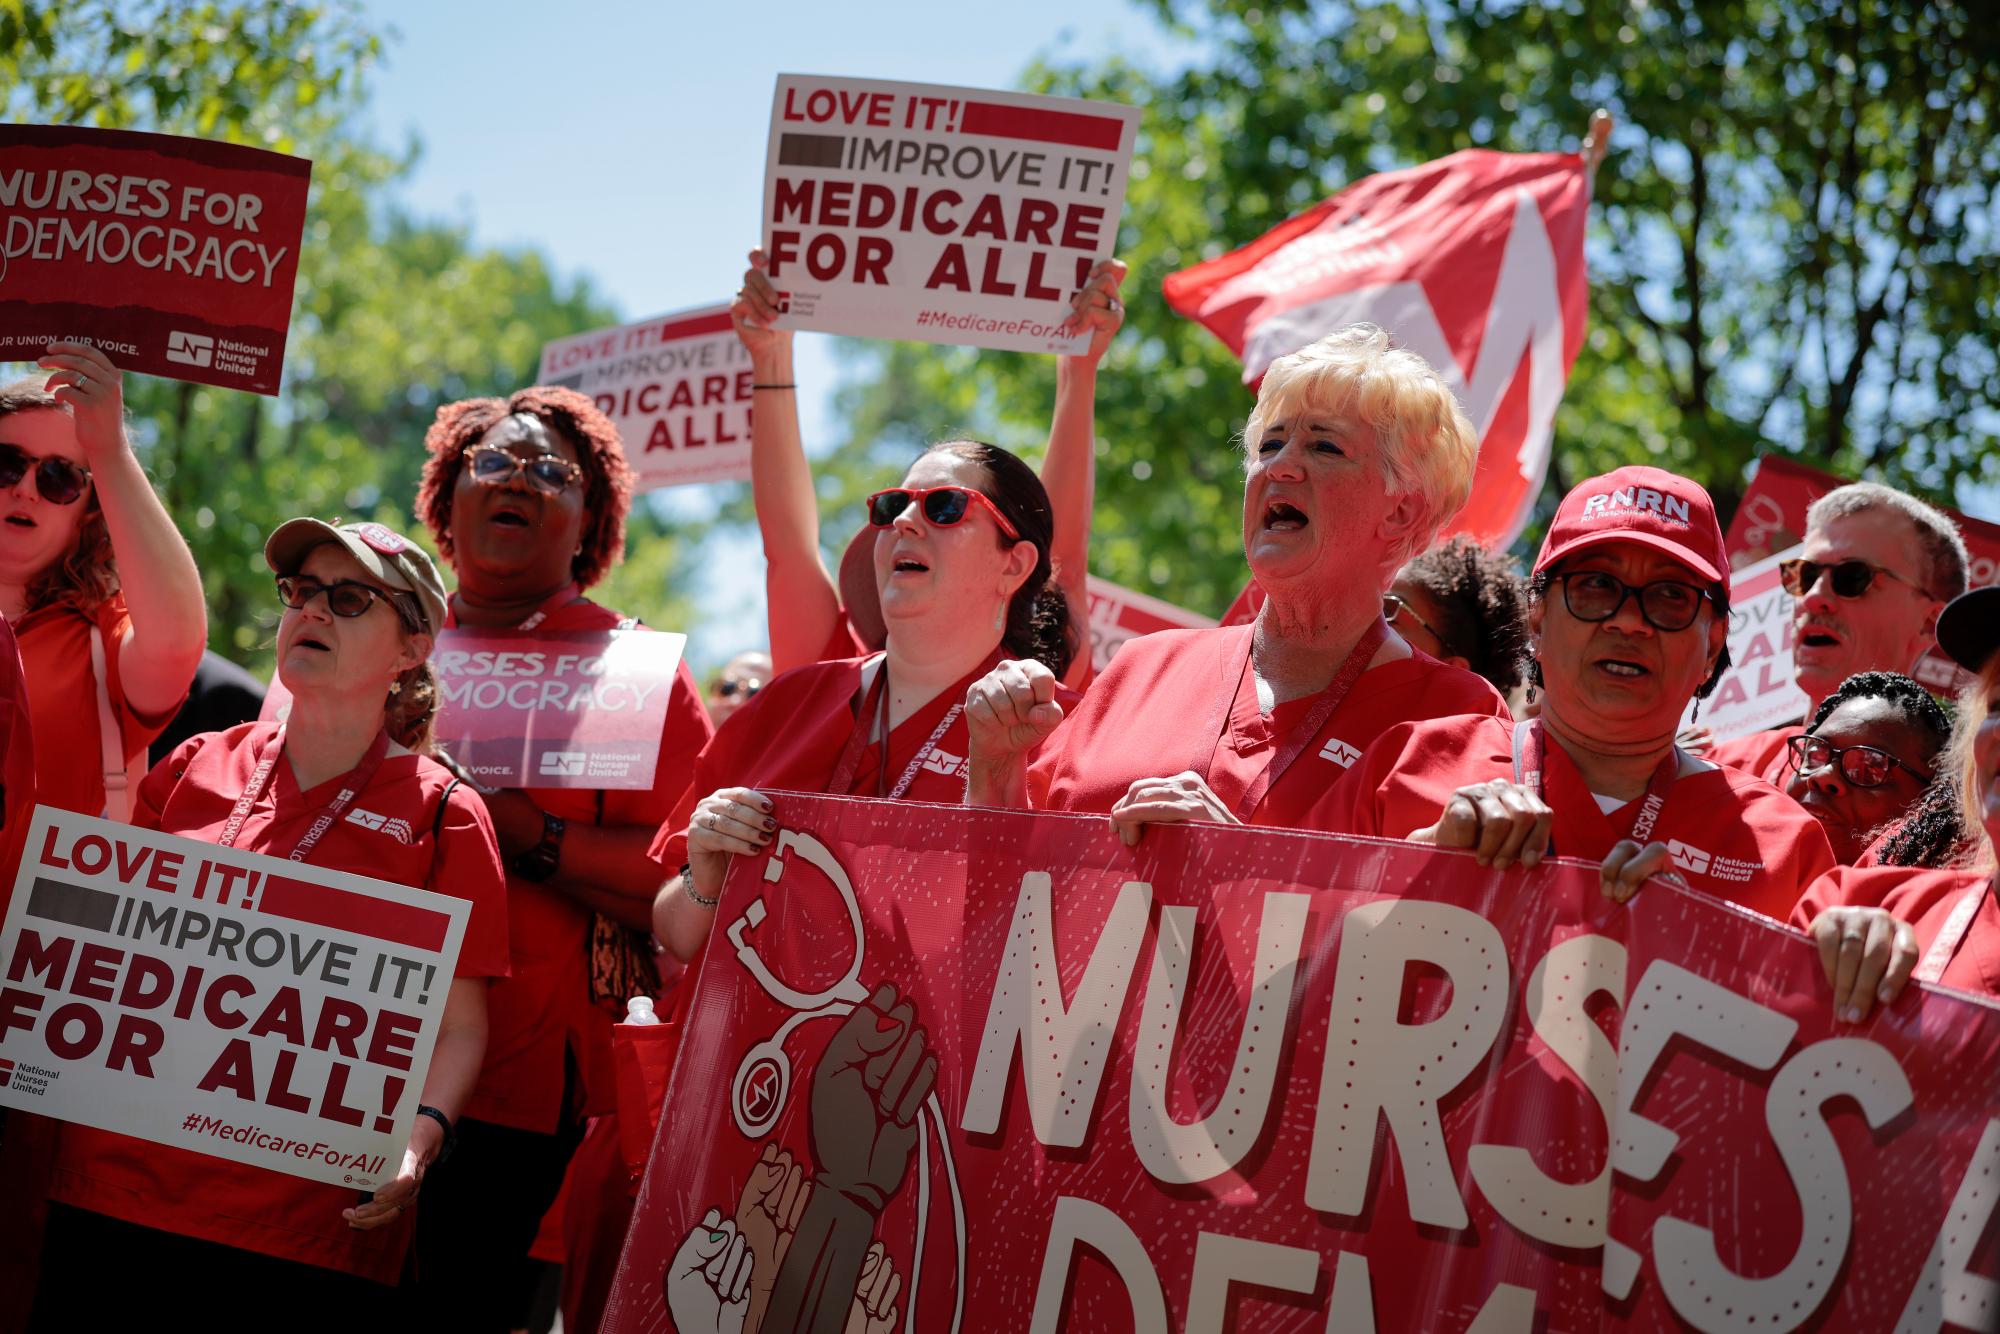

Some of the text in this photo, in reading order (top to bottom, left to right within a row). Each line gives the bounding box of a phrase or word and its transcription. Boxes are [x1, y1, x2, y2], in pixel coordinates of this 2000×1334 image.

[783, 87, 960, 133] LOVE IT!
[847, 137, 1115, 195] IMPROVE IT!
[0, 168, 263, 232] NURSES FOR
[773, 178, 1105, 251] MEDICARE
[5, 215, 287, 288] DEMOCRACY
[768, 231, 1094, 304] FOR ALL!
[97, 338, 140, 356] VOICE.
[216, 350, 257, 366] Nurses
[218, 339, 269, 357] National
[215, 360, 255, 376] United
[594, 371, 754, 419] DICARE
[1583, 486, 1689, 522] RNRN
[440, 650, 546, 678] RSES
[442, 679, 657, 712] MOCRACY
[930, 703, 965, 740] NURSES
[471, 765, 514, 776] VOICE.
[587, 768, 628, 777] United
[589, 761, 630, 769] Nurses
[591, 752, 641, 761] National
[890, 761, 922, 800] DEMOCR
[218, 759, 273, 848] NURSES FOR DEMOC
[1631, 793, 1664, 841] NURSES
[298, 815, 332, 848] FEDERAL
[40, 825, 262, 910] LOVE IT!
[1709, 869, 1752, 882] United
[1711, 862, 1754, 876] Nurses
[1714, 855, 1766, 870] National
[117, 897, 437, 1006] IMPROVE IT!
[6, 928, 423, 1072] MEDICARE
[0, 987, 407, 1135] FOR ALL!
[18, 1062, 60, 1080] National
[12, 1080, 46, 1096] United
[14, 1071, 49, 1087] Nurses
[182, 1112, 387, 1175] #MedicareForAll
